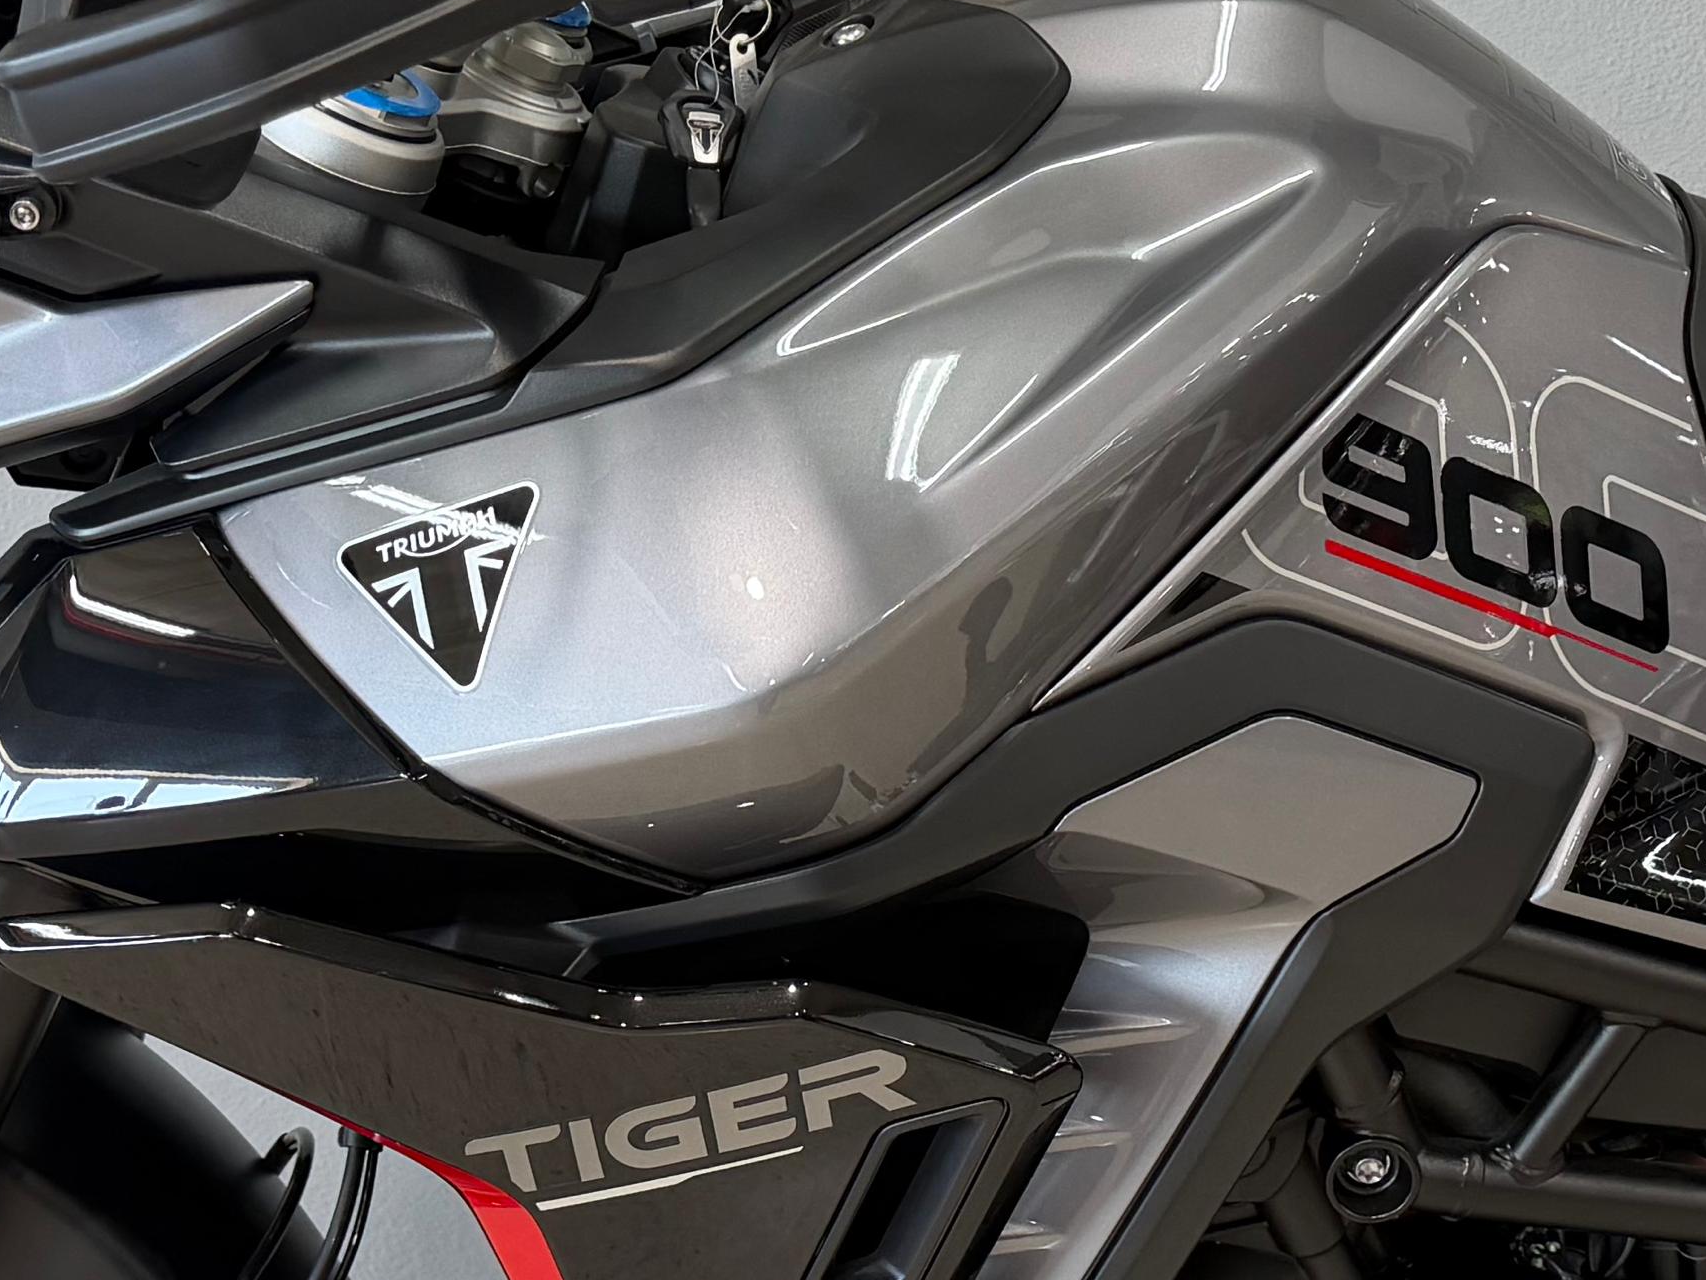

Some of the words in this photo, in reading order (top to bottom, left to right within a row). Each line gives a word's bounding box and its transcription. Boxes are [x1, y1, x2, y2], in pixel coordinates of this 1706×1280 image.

[375, 505, 498, 563] TRIUMPH
[1322, 412, 1670, 655] 900
[464, 1048, 918, 1194] TIGER
